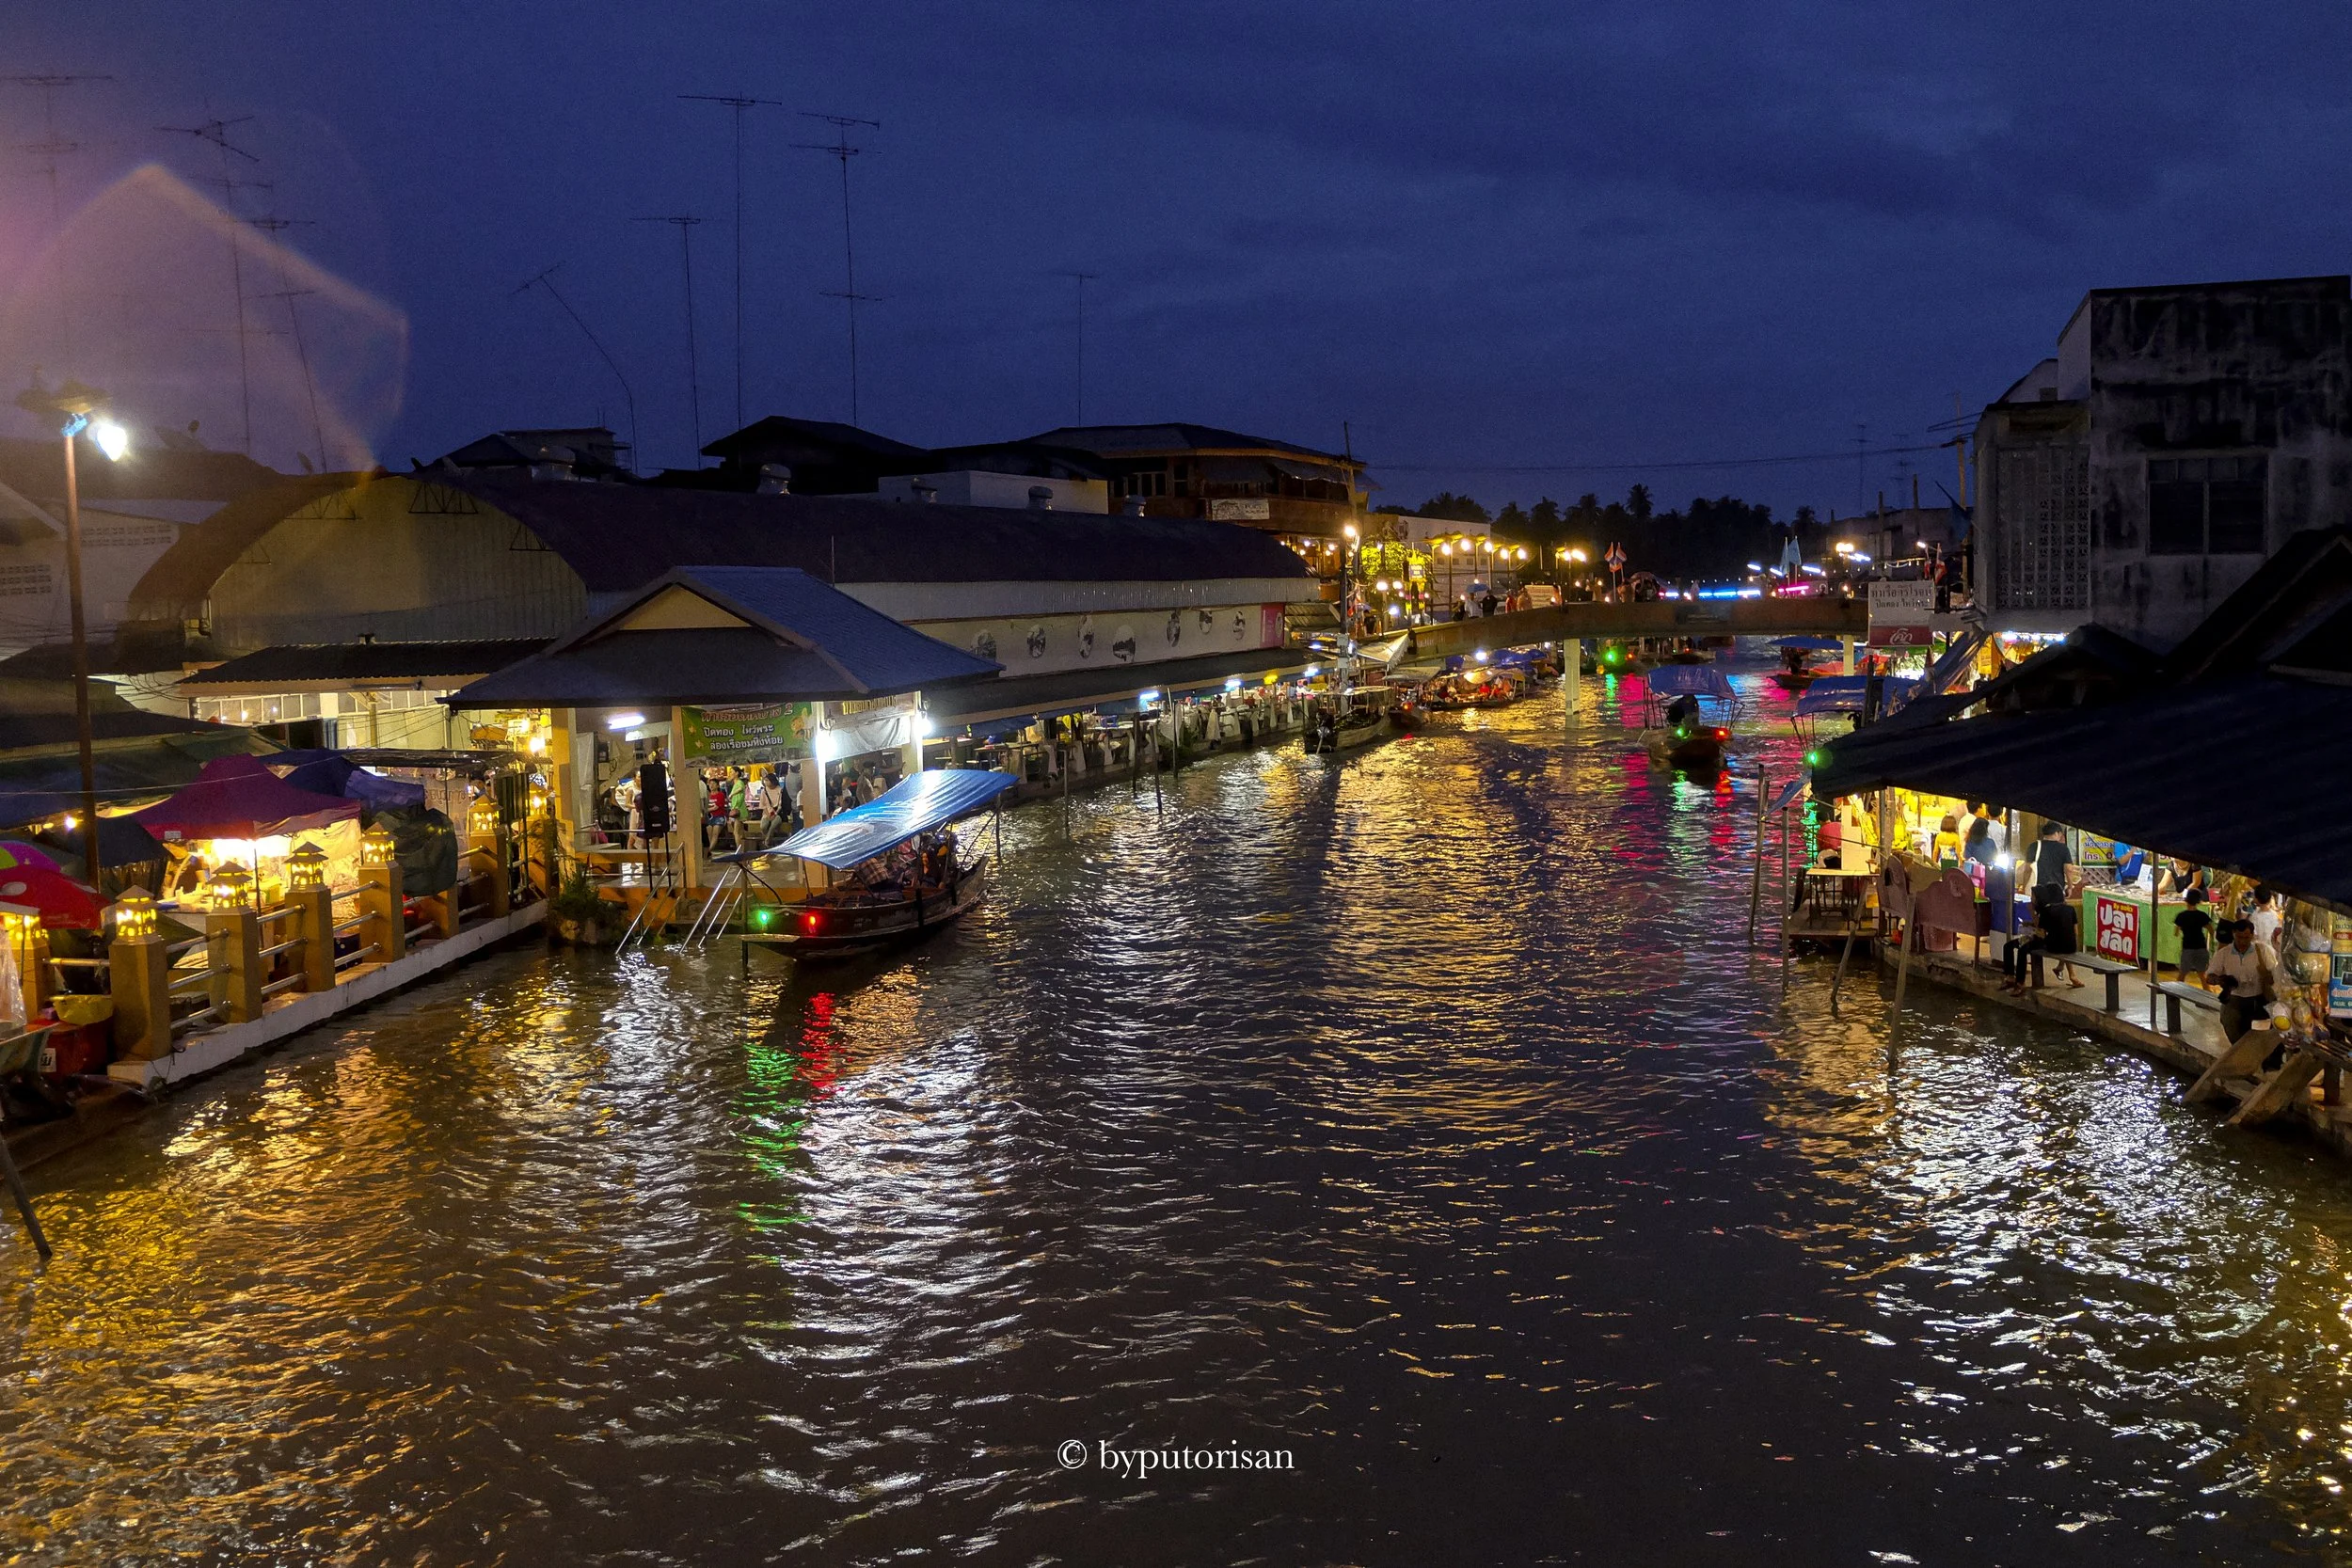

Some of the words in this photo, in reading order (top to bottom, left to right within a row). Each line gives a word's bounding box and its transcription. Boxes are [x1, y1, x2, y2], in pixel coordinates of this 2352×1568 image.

[704, 726, 734, 737] ปิดทอง
[741, 723, 775, 735] ไหว้พระ
[2100, 904, 2134, 931] ปลา
[2100, 927, 2133, 956] สลิด
